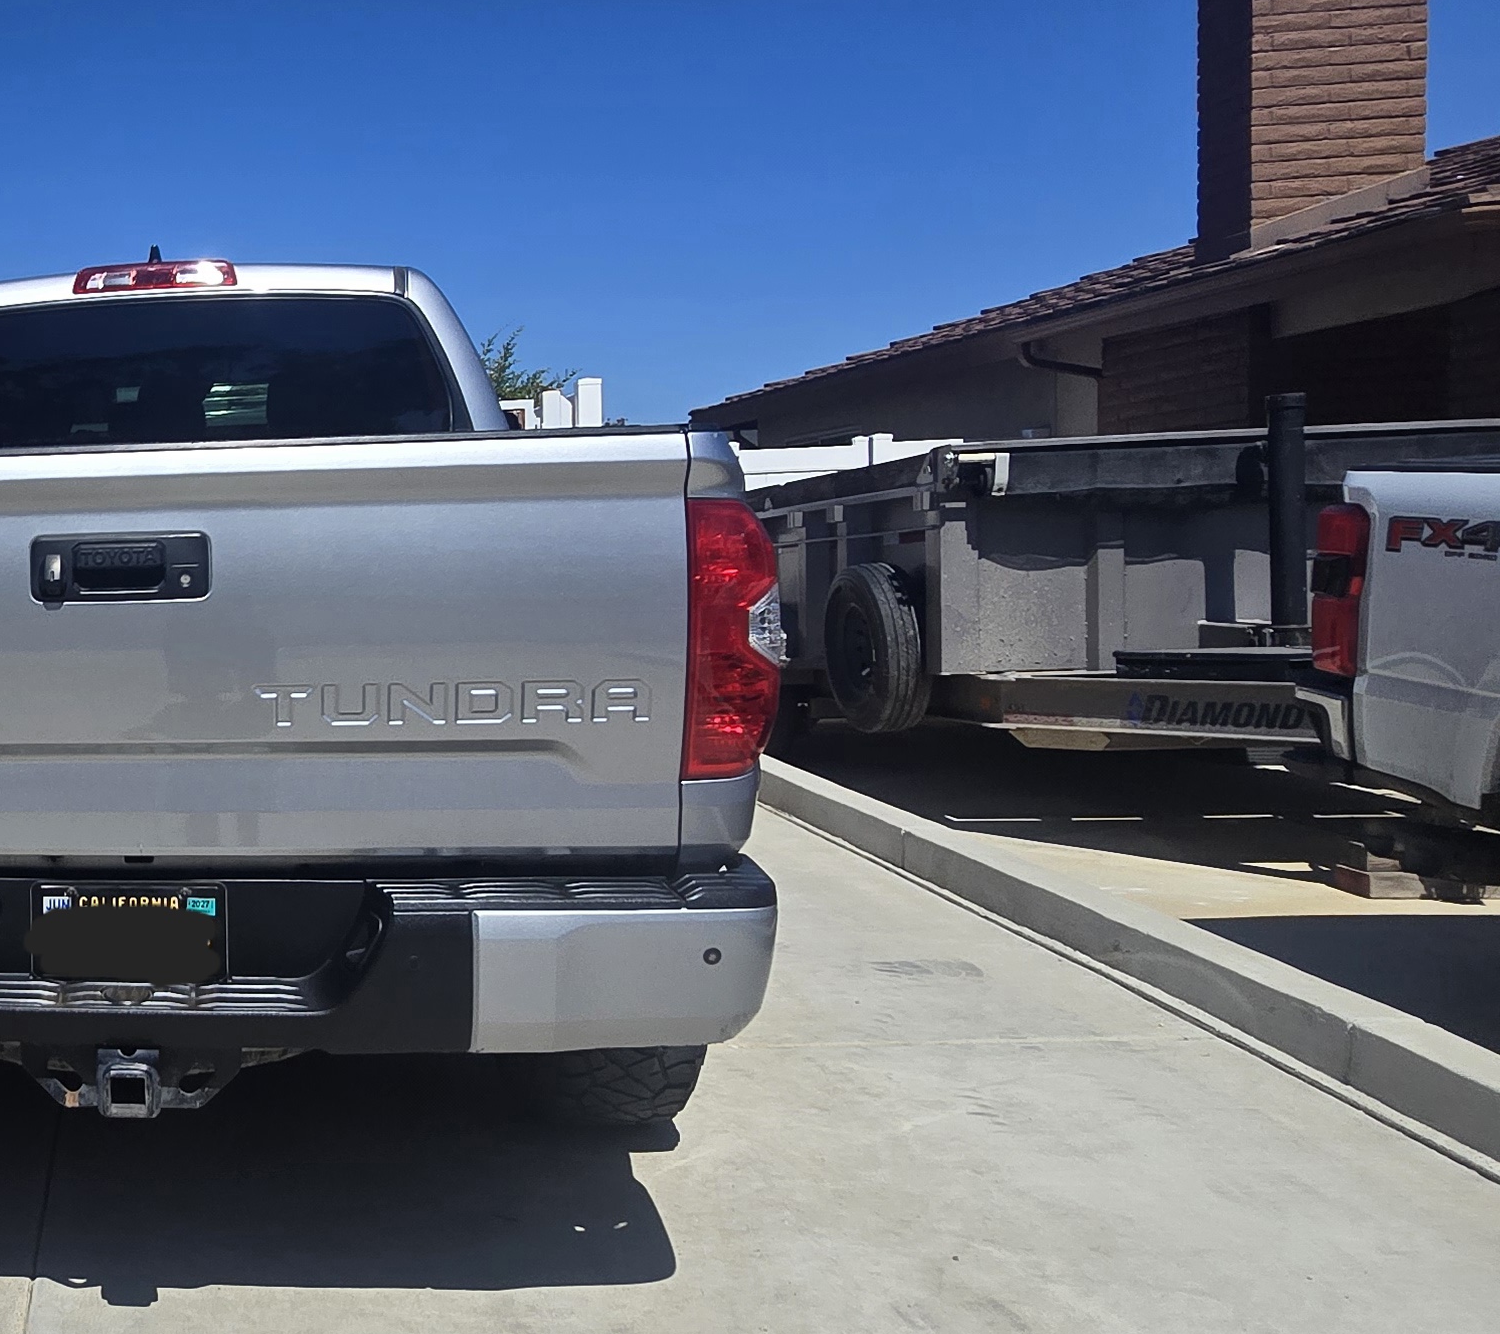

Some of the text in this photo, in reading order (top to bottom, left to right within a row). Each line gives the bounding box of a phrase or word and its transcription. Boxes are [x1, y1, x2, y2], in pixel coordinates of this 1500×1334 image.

[1385, 515, 1500, 553] FX4
[80, 548, 157, 565] TOYOTA
[252, 679, 653, 727] TUNDRA
[1141, 694, 1306, 729] DIAMOND
[45, 897, 70, 910] JUN
[191, 899, 210, 908] 2027
